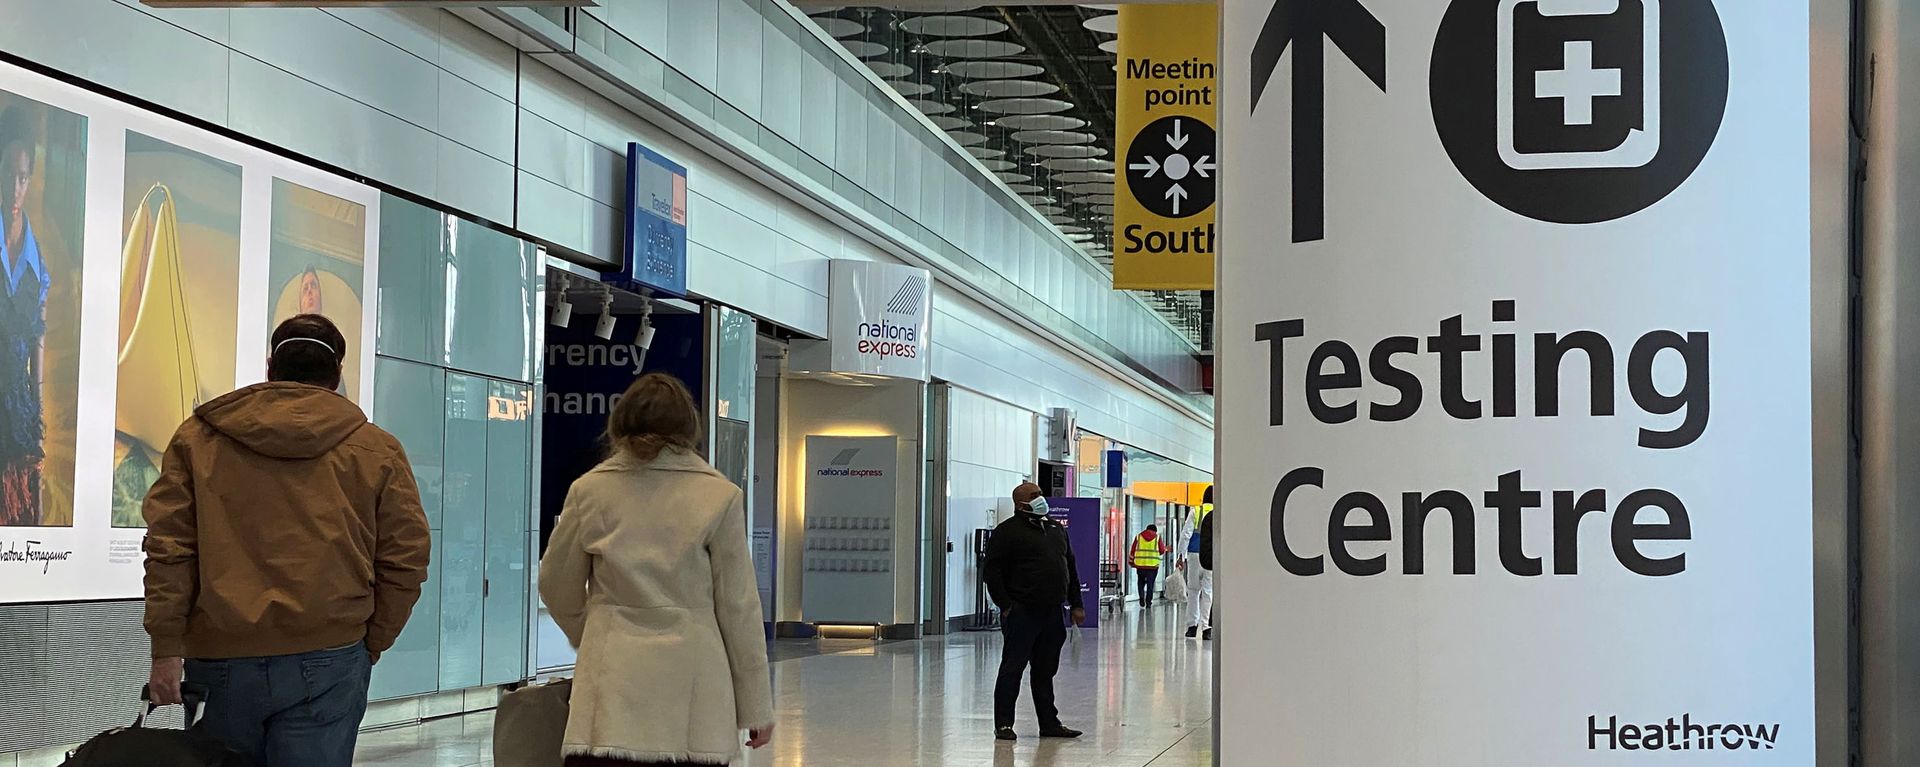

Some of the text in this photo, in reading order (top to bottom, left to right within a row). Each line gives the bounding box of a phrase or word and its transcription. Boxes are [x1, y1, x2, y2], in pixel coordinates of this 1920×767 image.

[1126, 57, 1217, 80] Meetin
[1145, 83, 1212, 112] point
[858, 319, 917, 342] national
[544, 343, 648, 376] rency
[857, 339, 917, 361] express
[1254, 299, 1710, 449] Testing
[817, 467, 883, 478] national express
[1269, 466, 1692, 577] Centre
[25, 540, 73, 575] Ferragamo
[1587, 713, 1780, 751] Heathrow
